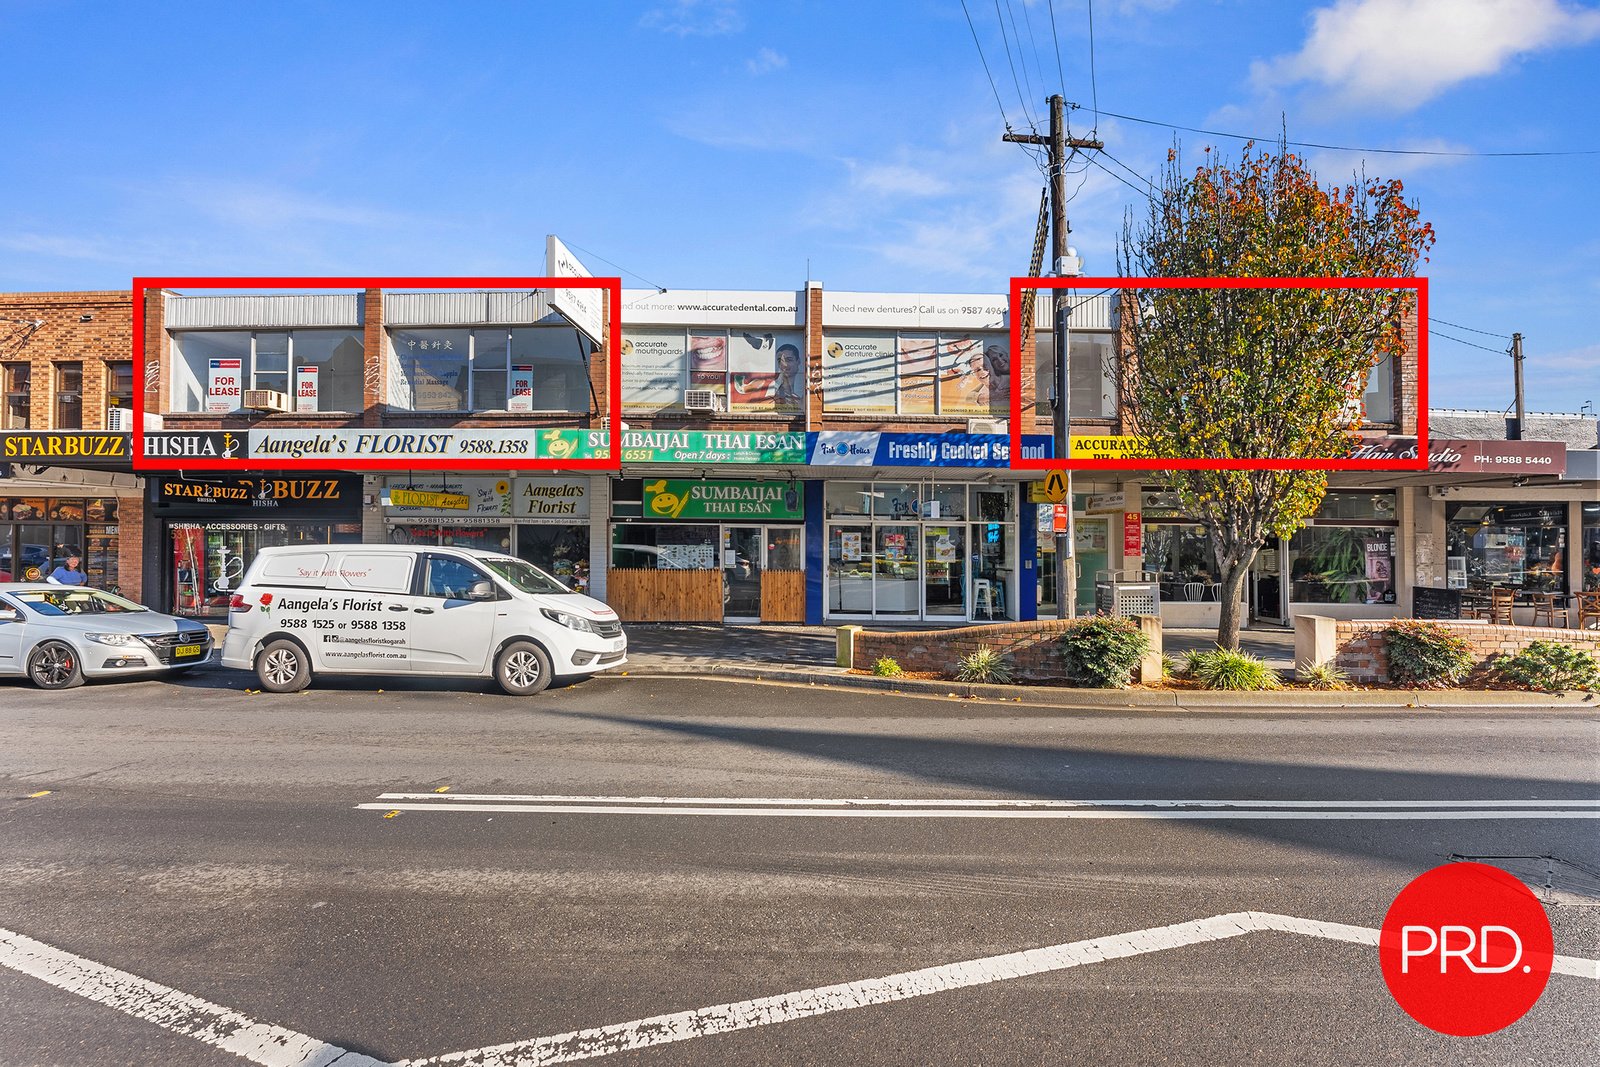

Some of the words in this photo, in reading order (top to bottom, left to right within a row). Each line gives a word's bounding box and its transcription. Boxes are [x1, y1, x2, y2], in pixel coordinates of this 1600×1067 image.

[677, 304, 798, 313] www.accuratedental.com.au
[832, 304, 855, 314] Need
[876, 305, 917, 314] dentures?
[919, 306, 935, 314] Call
[961, 306, 982, 315] 9587
[985, 307, 1007, 316] 4964
[215, 377, 234, 385] FOR
[210, 388, 240, 396] LEASE
[5, 436, 124, 457] STARBUZZ
[130, 436, 217, 456] HISHA
[254, 434, 347, 458] Aangela's
[354, 434, 454, 454] FLORIST
[459, 439, 529, 454] 9588.1358
[702, 434, 750, 449] THAI
[755, 434, 804, 450] ESAN
[821, 443, 835, 454] Fish
[625, 450, 652, 459] 6551
[674, 451, 697, 460] Open
[889, 442, 937, 462] Freshly
[942, 442, 988, 460] Cooked
[993, 442, 1045, 460] Seood
[1349, 444, 1394, 459] Hair
[1399, 445, 1462, 463] Sudio
[1474, 455, 1493, 464] PH:
[1495, 456, 1522, 464] 9588
[164, 483, 202, 496] STAR
[213, 487, 248, 500] BUZZ
[272, 480, 340, 499] BUZZ
[523, 483, 584, 498] Aangela's
[691, 486, 782, 502] SUMBAIJAI
[403, 492, 439, 506] FLORIST
[528, 500, 576, 514] Florist
[704, 503, 735, 513] THAI
[739, 503, 772, 513] ESAN
[1367, 543, 1388, 551] BLONDE
[278, 598, 338, 612] Aangela's
[343, 599, 383, 611] Florist
[280, 619, 307, 628] 9588
[312, 620, 334, 629] 1525
[351, 620, 378, 630] 9588
[382, 621, 406, 630] 1358
